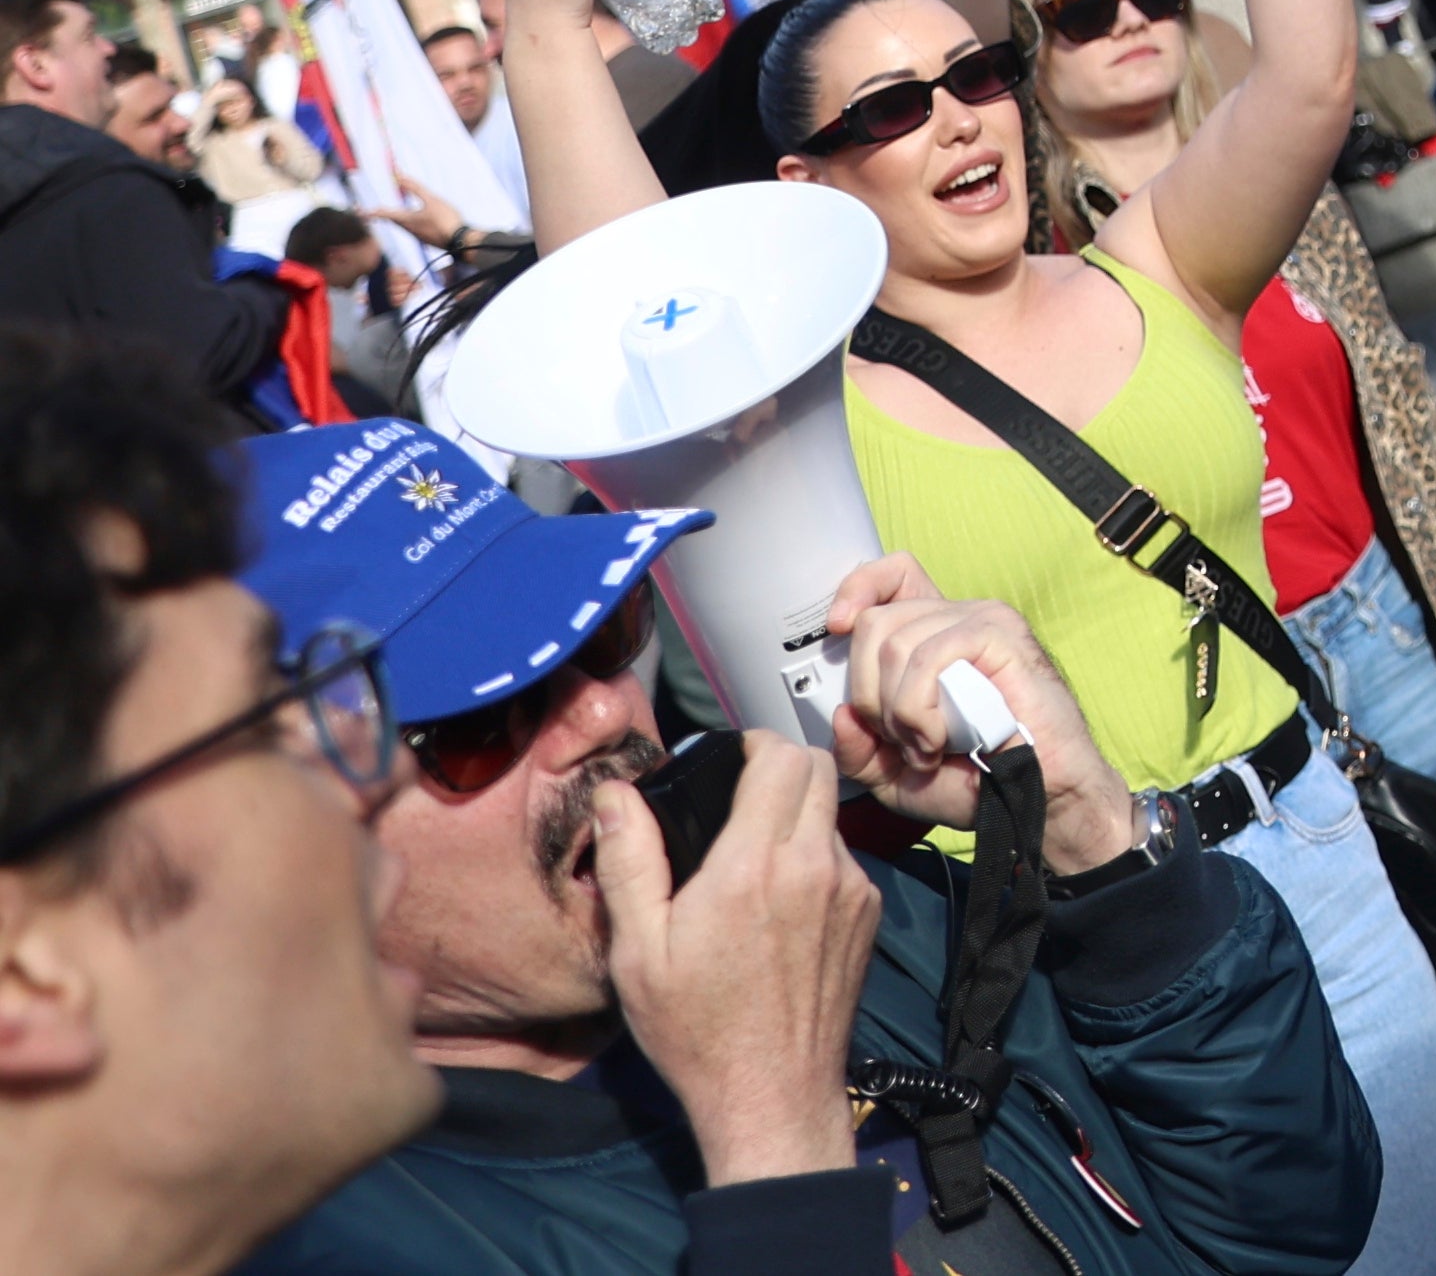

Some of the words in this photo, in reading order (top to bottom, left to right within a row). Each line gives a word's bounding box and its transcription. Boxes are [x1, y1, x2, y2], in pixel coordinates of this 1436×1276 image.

[281, 446, 374, 528] Relais
[317, 446, 411, 533] Restaurant
[403, 536, 436, 565] Col
[430, 521, 455, 541] du
